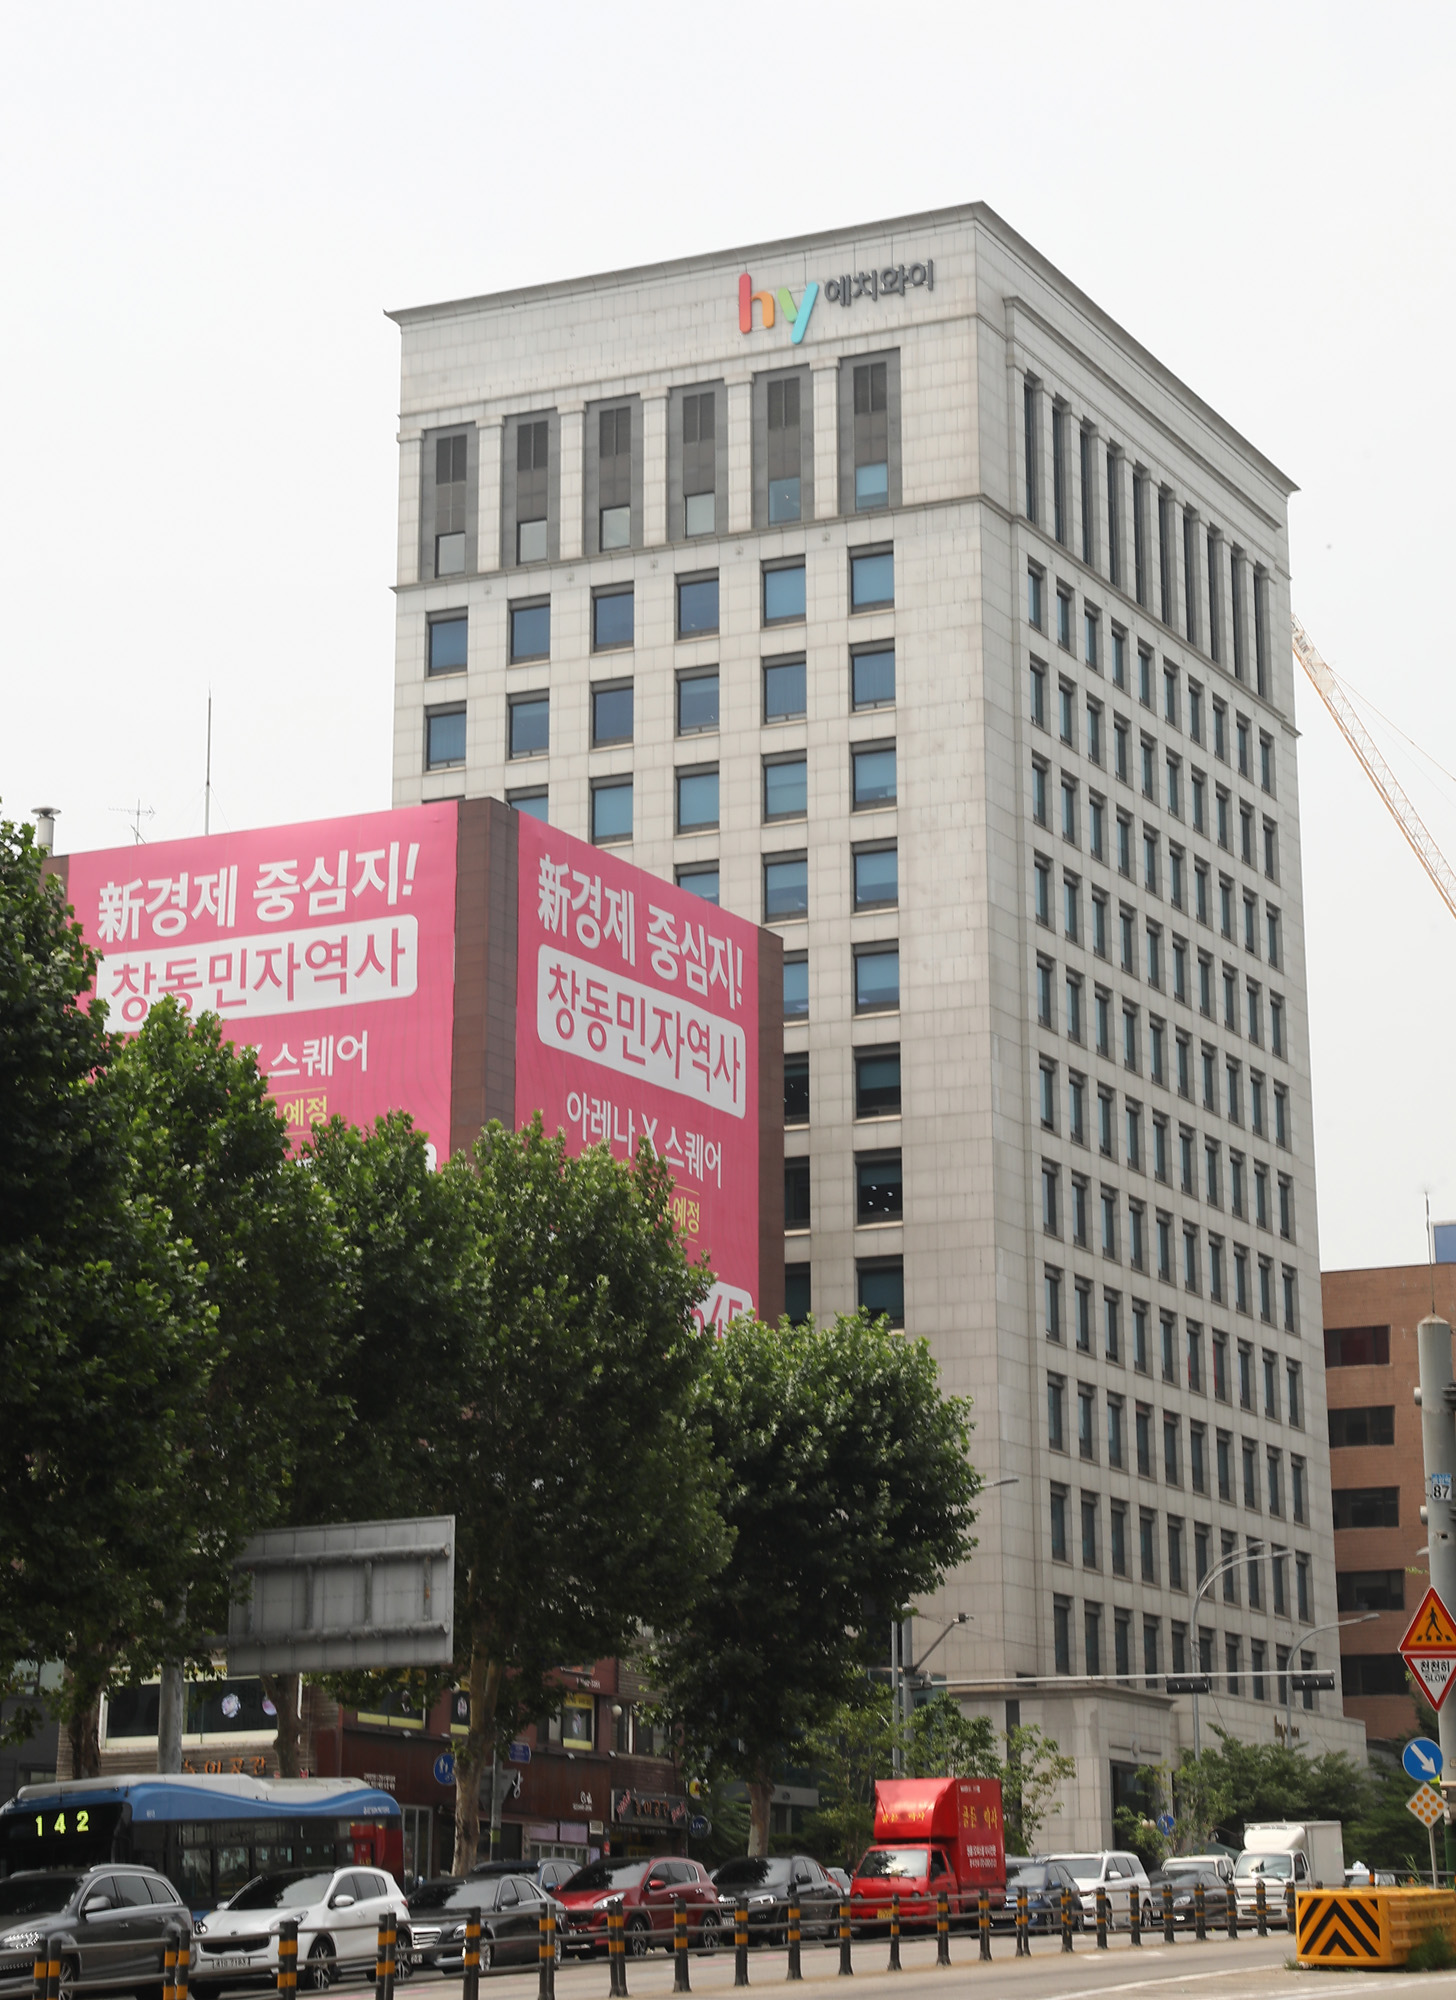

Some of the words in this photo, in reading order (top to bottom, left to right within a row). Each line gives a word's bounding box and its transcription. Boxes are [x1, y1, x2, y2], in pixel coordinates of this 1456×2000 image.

[738, 272, 820, 345] hy
[824, 258, 934, 307] 에치와이
[97, 864, 239, 943] 新경제
[252, 841, 421, 923] 중심지!
[537, 853, 636, 968] 新경제
[646, 903, 744, 1011] 중심지!
[110, 926, 407, 1024] 창동민자역사
[266, 1029, 369, 1078] 스퀘어
[547, 963, 742, 1105] 창동민자역사
[566, 1091, 636, 1158] 아레나
[664, 1126, 722, 1190] 스퀘어
[1433, 1483, 1451, 1500] 87
[1421, 1660, 1450, 1673] 천천히
[1424, 1674, 1448, 1684] SLOW
[35, 1809, 90, 1838] 142
